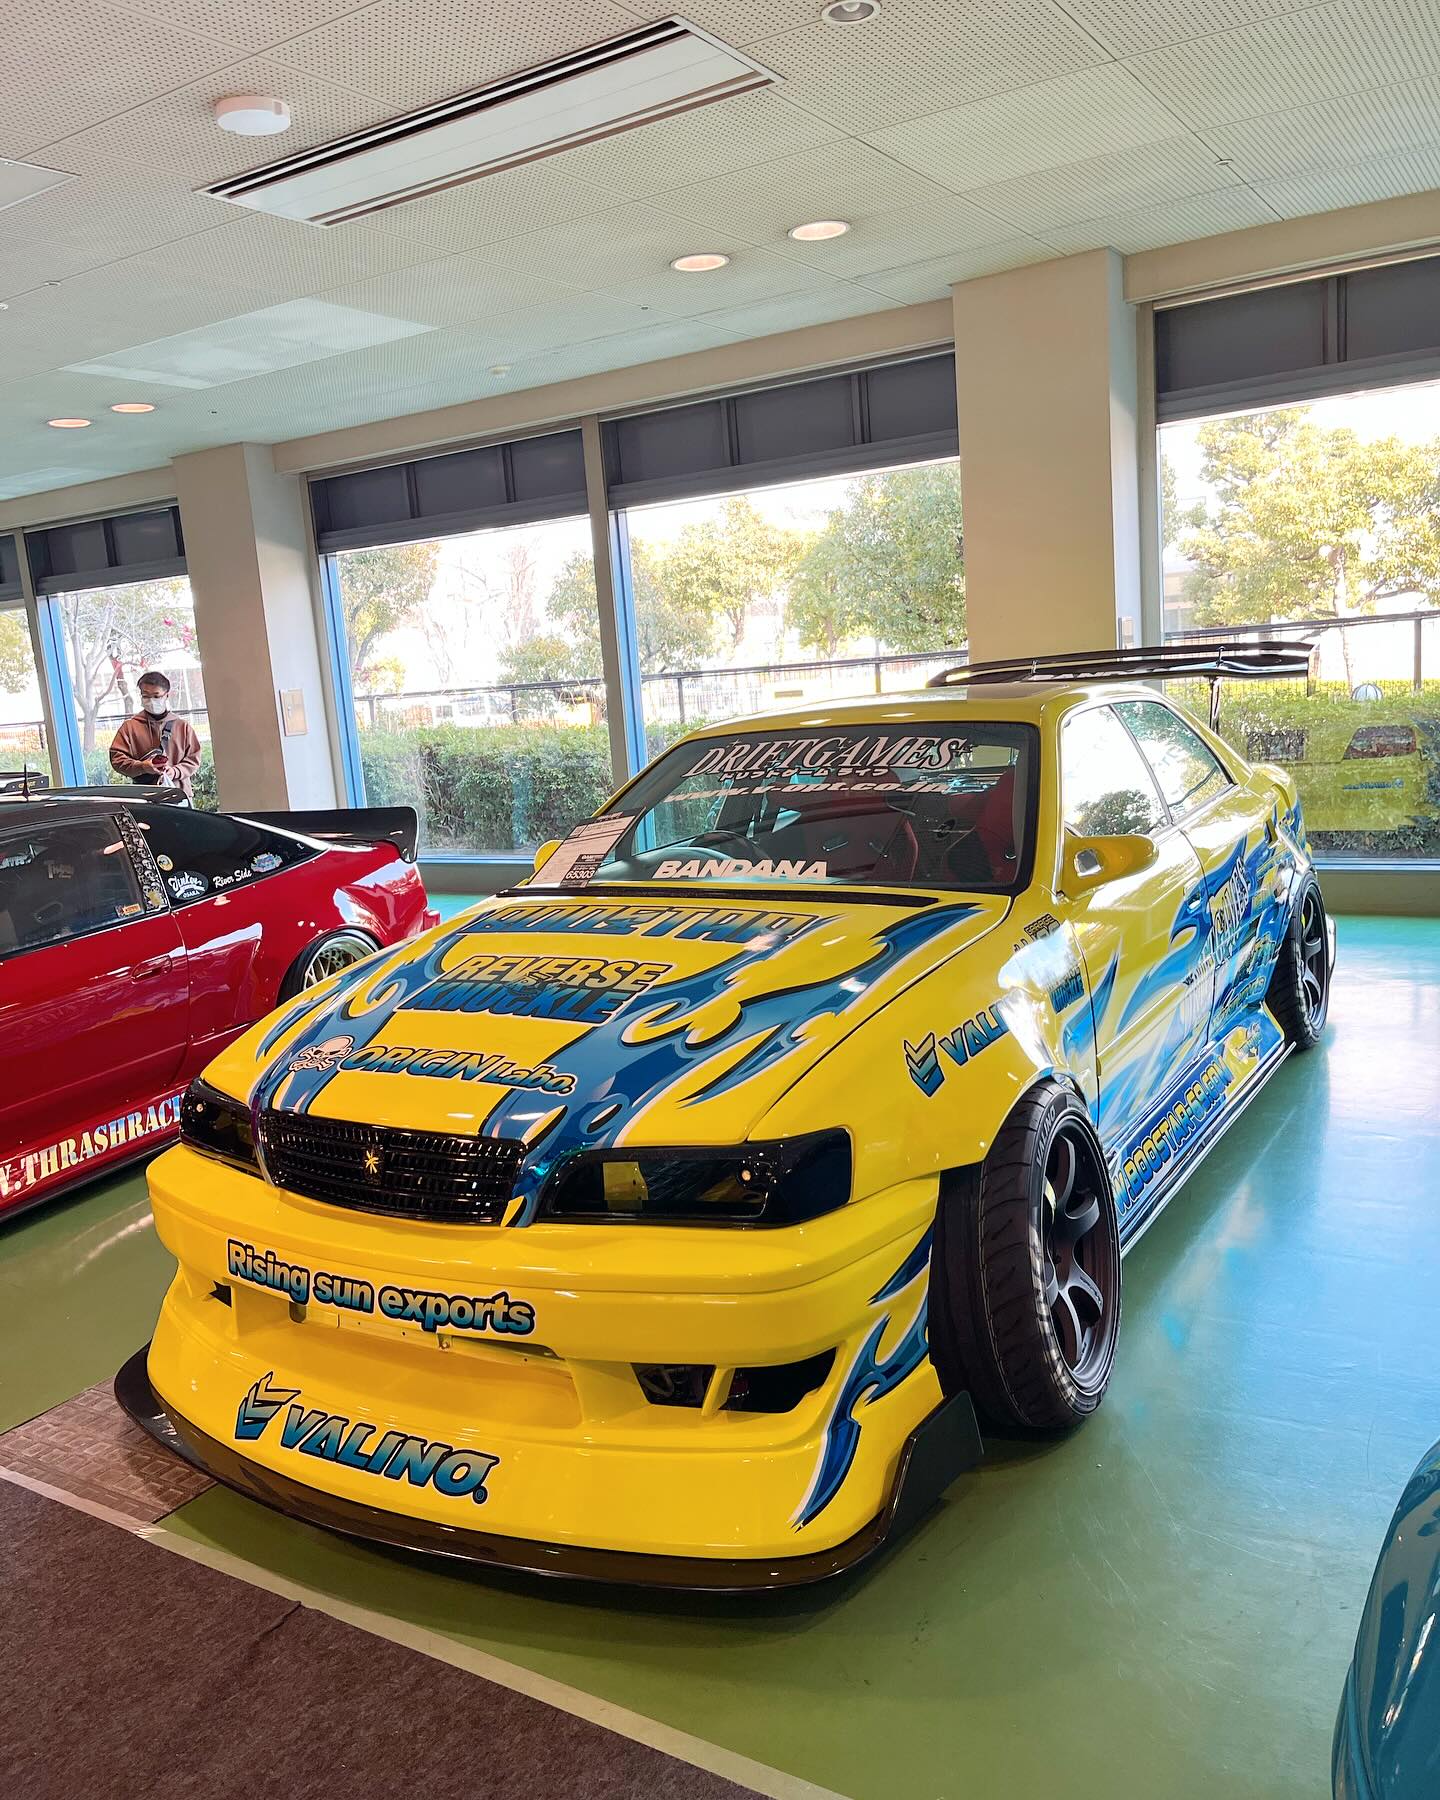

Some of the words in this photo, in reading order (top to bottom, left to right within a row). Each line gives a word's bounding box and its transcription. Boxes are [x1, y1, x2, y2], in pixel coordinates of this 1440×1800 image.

[682, 736, 966, 778] DRIFTGAMES
[213, 875, 235, 888] River
[234, 868, 252, 881] Side
[566, 871, 595, 879] 65303
[652, 859, 828, 880] BANDANA
[440, 955, 672, 992] REVERSE
[403, 980, 639, 1024] KNUCKLE
[938, 998, 1010, 1066] VALI
[341, 1046, 506, 1081] ORIGIN
[228, 1239, 310, 1305] Rising
[313, 1272, 374, 1313] sun
[378, 1286, 535, 1335] exports
